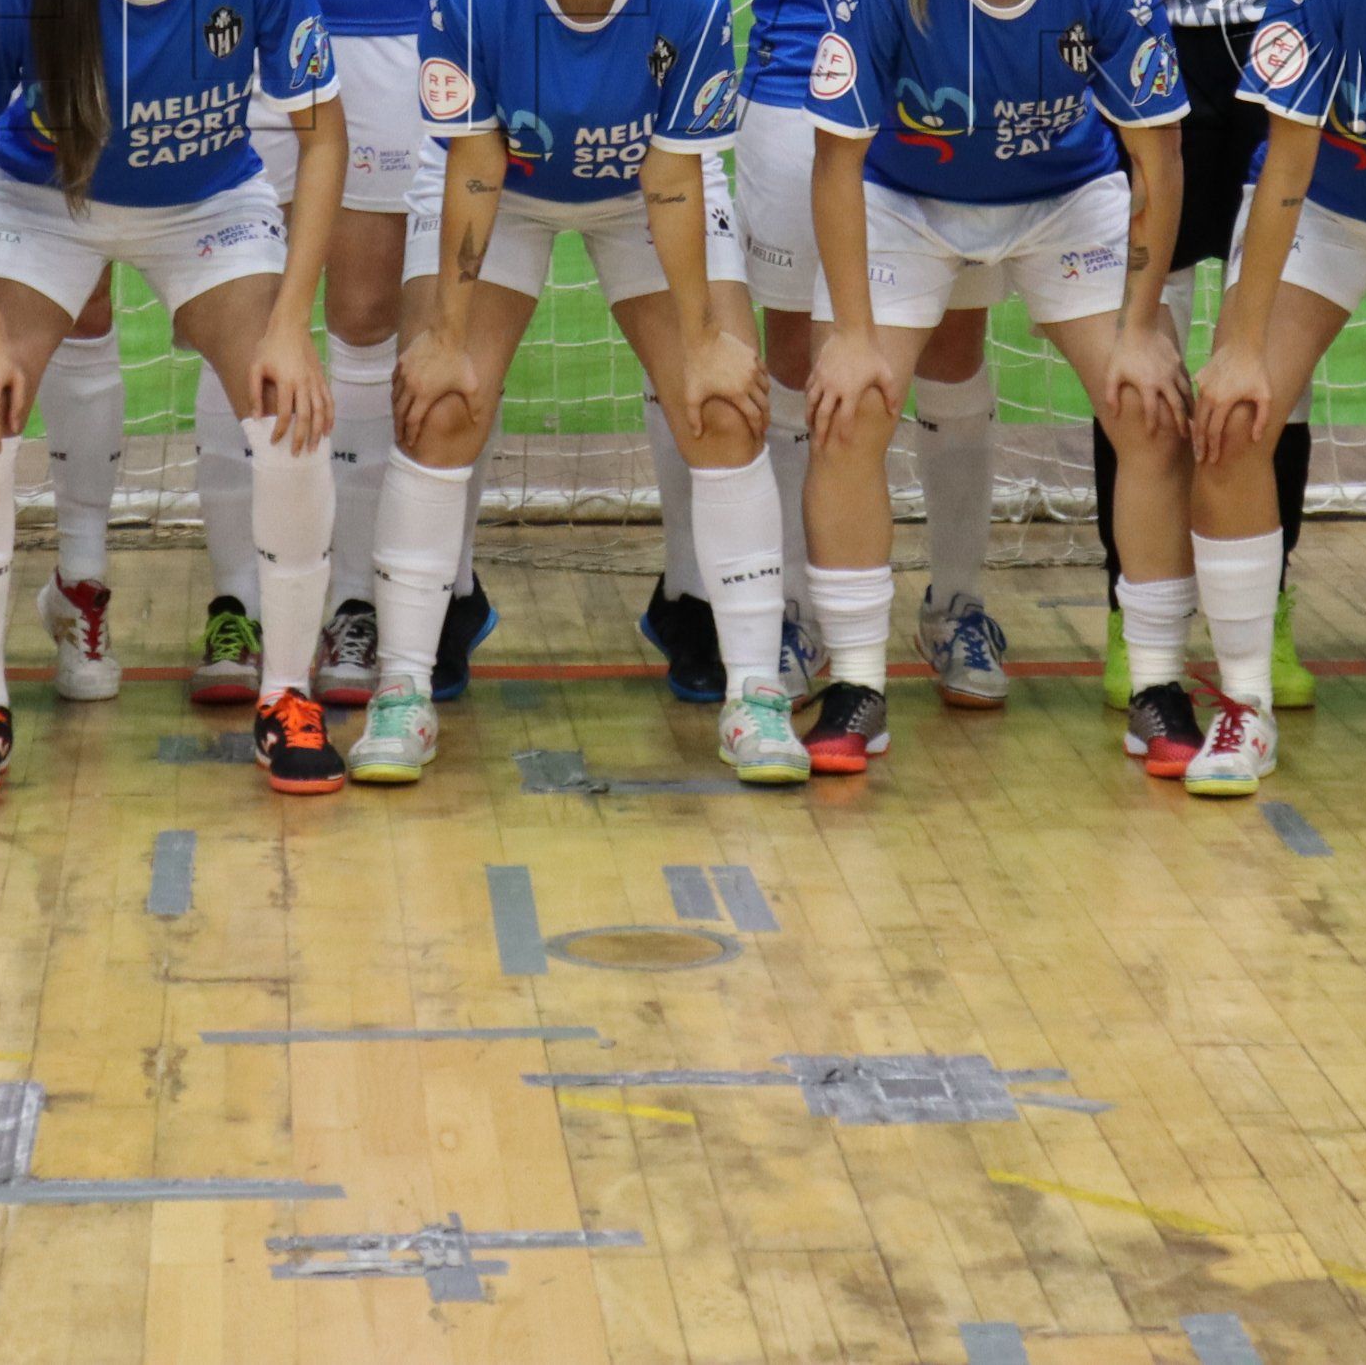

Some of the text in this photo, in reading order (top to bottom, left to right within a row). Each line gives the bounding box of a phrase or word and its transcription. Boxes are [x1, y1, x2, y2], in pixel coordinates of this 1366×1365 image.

[129, 102, 241, 148] SPORT
[574, 112, 655, 146] MELI
[127, 125, 245, 168] CAPITA
[574, 142, 647, 164] SPO
[752, 245, 794, 268] MELILLA
